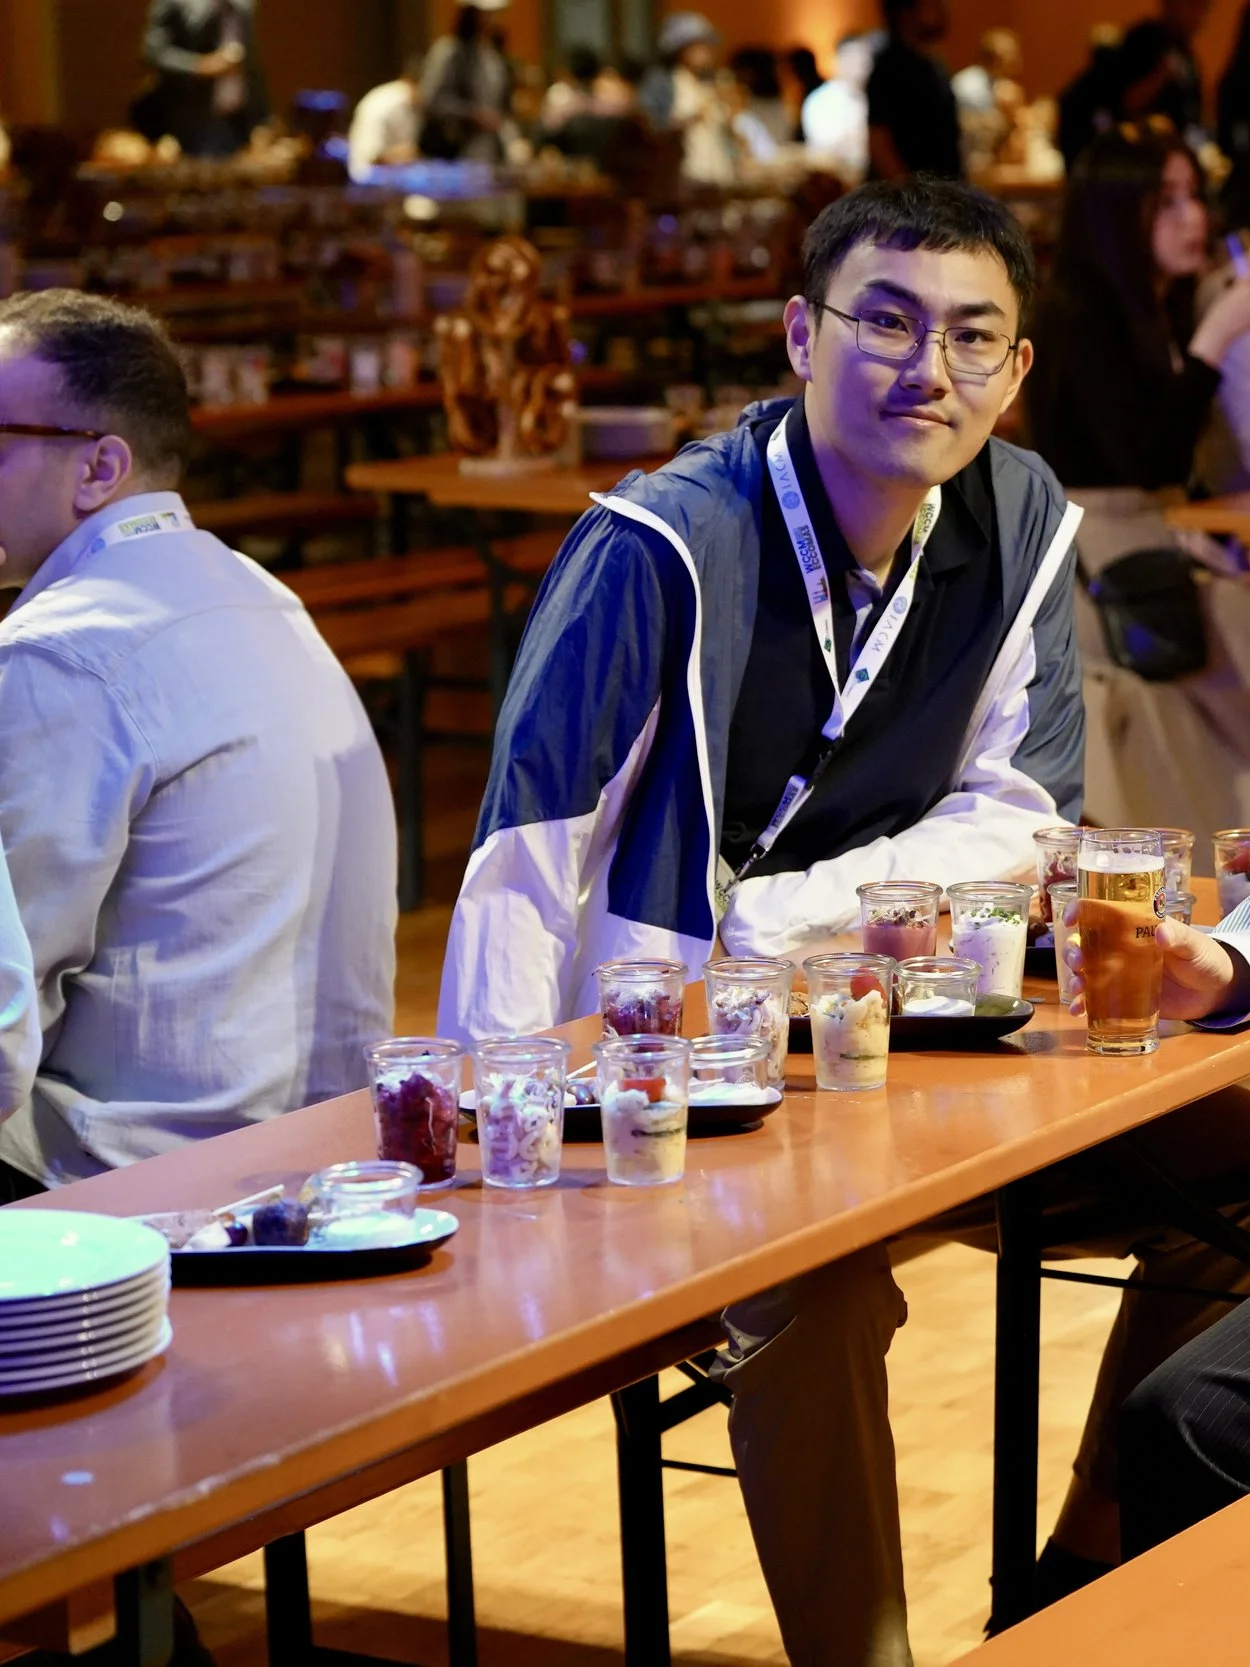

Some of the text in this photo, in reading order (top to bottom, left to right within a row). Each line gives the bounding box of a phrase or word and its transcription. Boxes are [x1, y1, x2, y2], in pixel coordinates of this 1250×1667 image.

[923, 503, 936, 533] WCCM
[796, 540, 814, 574] WCCM
[801, 524, 821, 571] ECCOMAS
